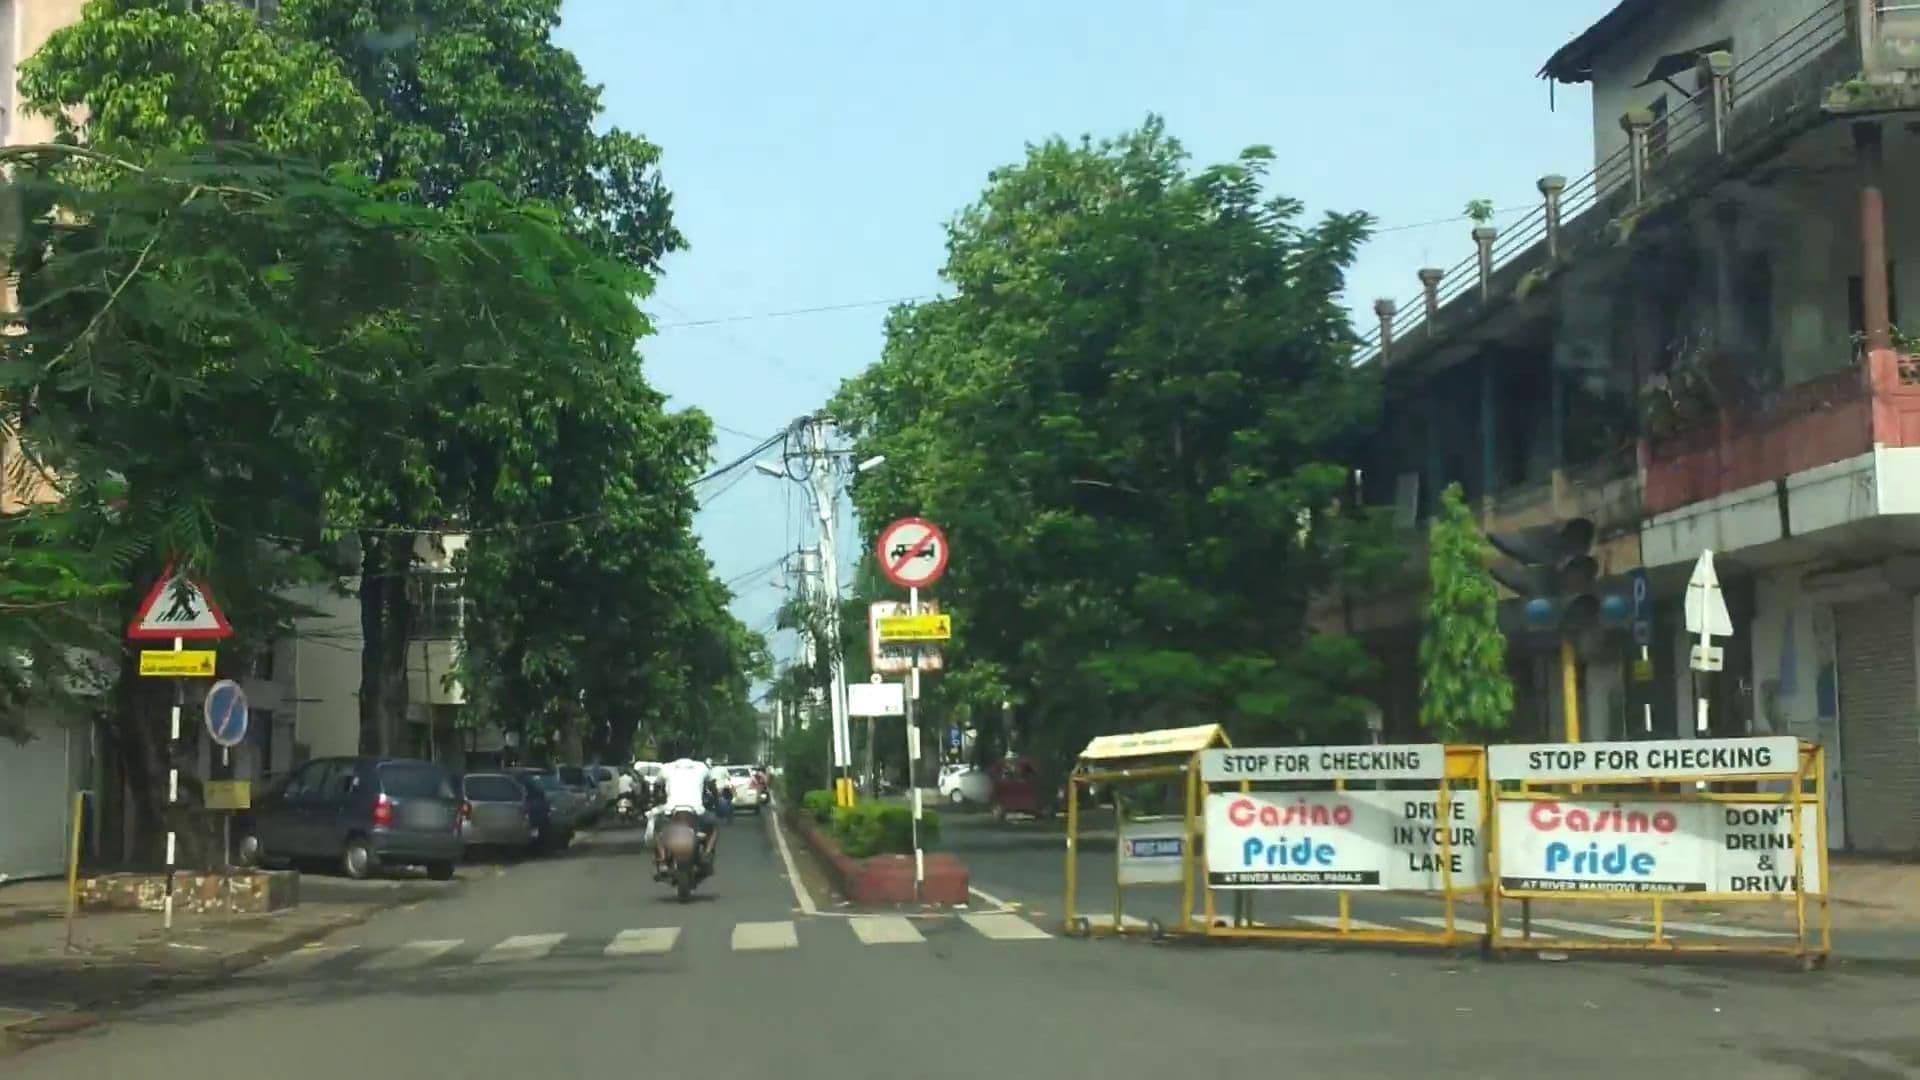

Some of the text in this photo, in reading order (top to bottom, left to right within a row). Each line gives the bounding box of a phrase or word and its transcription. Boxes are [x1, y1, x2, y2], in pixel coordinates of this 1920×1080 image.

[1223, 752, 1420, 773] STOP FOR CHECKING
[1529, 747, 1772, 770] STOP FOR CHECKING
[1228, 799, 1354, 828] Casino
[1405, 801, 1465, 820] DRIE
[1530, 800, 1678, 834] Casino
[1394, 826, 1476, 846] IN YOUR
[1243, 837, 1336, 866] Pride
[1410, 853, 1462, 872] LANE
[1545, 841, 1656, 875] Pride
[1757, 855, 1774, 871] &
